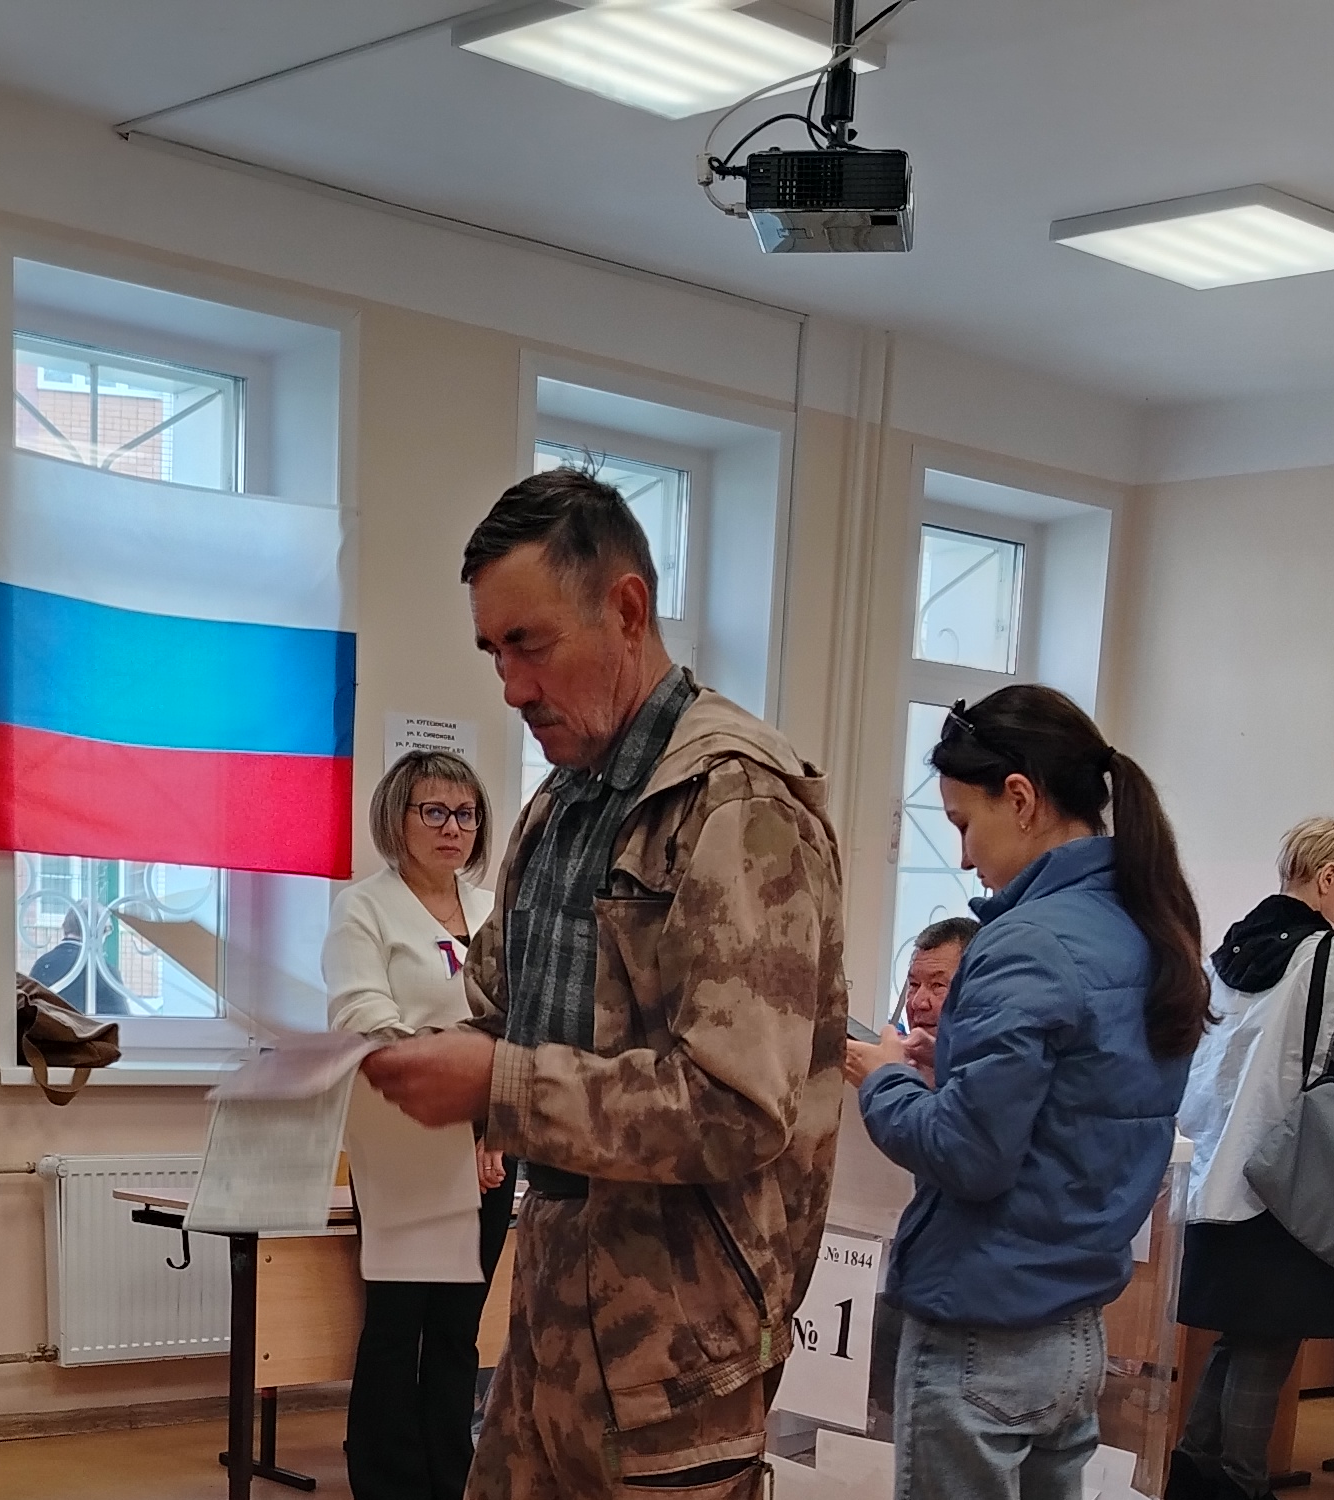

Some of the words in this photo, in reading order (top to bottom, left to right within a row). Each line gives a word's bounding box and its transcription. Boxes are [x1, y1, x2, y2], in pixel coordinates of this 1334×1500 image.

[824, 1246, 839, 1262] №
[843, 1250, 873, 1269] 1844
[792, 1318, 818, 1352] №
[829, 1298, 854, 1361] 1
